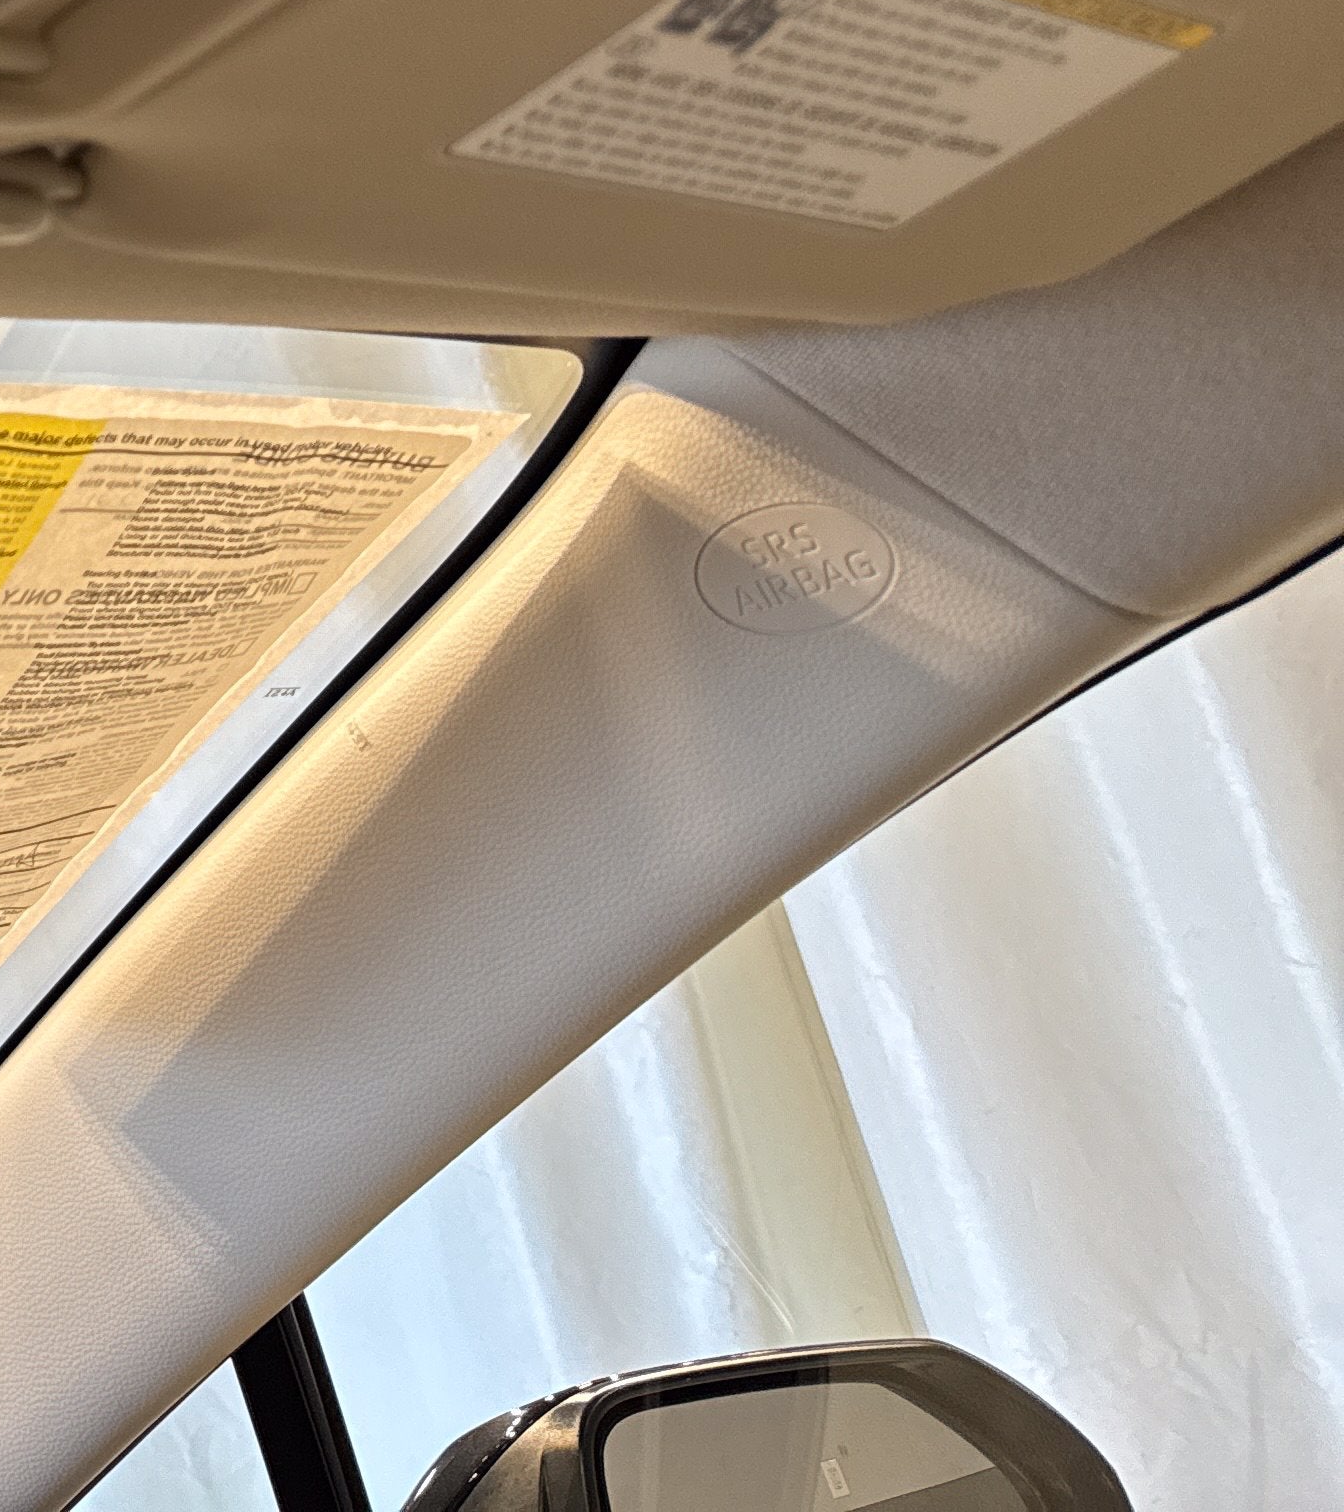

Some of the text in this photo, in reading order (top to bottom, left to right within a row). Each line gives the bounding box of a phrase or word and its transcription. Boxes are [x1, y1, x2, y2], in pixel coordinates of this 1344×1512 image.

[11, 429, 63, 445] major
[64, 432, 119, 445] defects
[119, 433, 154, 445] that
[151, 436, 187, 448] may
[187, 437, 232, 447] occur
[232, 436, 250, 449] in
[249, 439, 293, 452] used
[740, 521, 821, 570] SRS
[735, 548, 882, 617] AIRBAG
